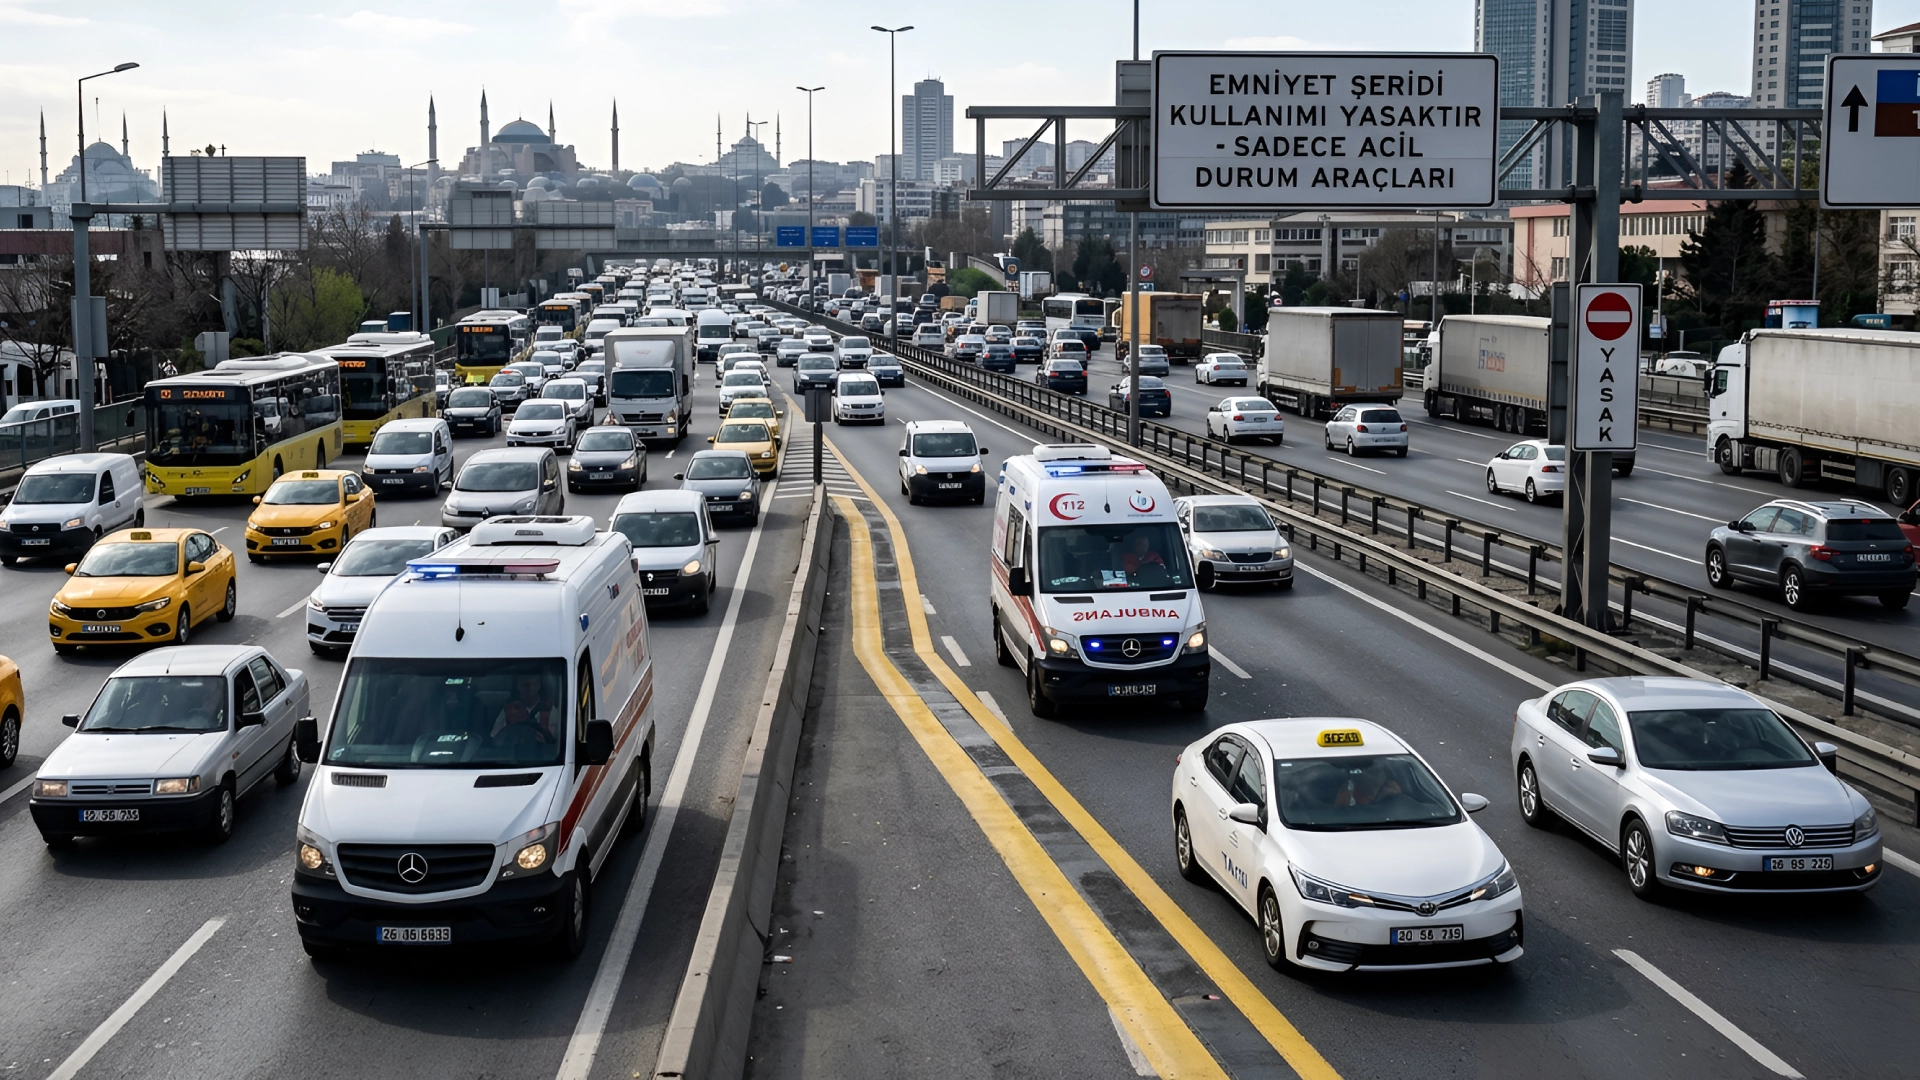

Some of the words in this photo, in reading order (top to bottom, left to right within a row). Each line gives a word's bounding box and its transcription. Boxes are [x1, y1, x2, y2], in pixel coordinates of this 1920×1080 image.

[1209, 69, 1337, 96] EMNİYET
[1350, 69, 1443, 100] ŞERİDİ
[1170, 104, 1326, 126] KULLANIMI
[1340, 105, 1482, 127] YASAKTIR
[1233, 135, 1346, 157] SADECE
[1357, 130, 1424, 158] ACİL
[1195, 166, 1298, 188] DURUM
[1310, 166, 1454, 192] ARAÇLARI
[1598, 347, 1616, 442] YASAK
[1062, 501, 1085, 510] 112
